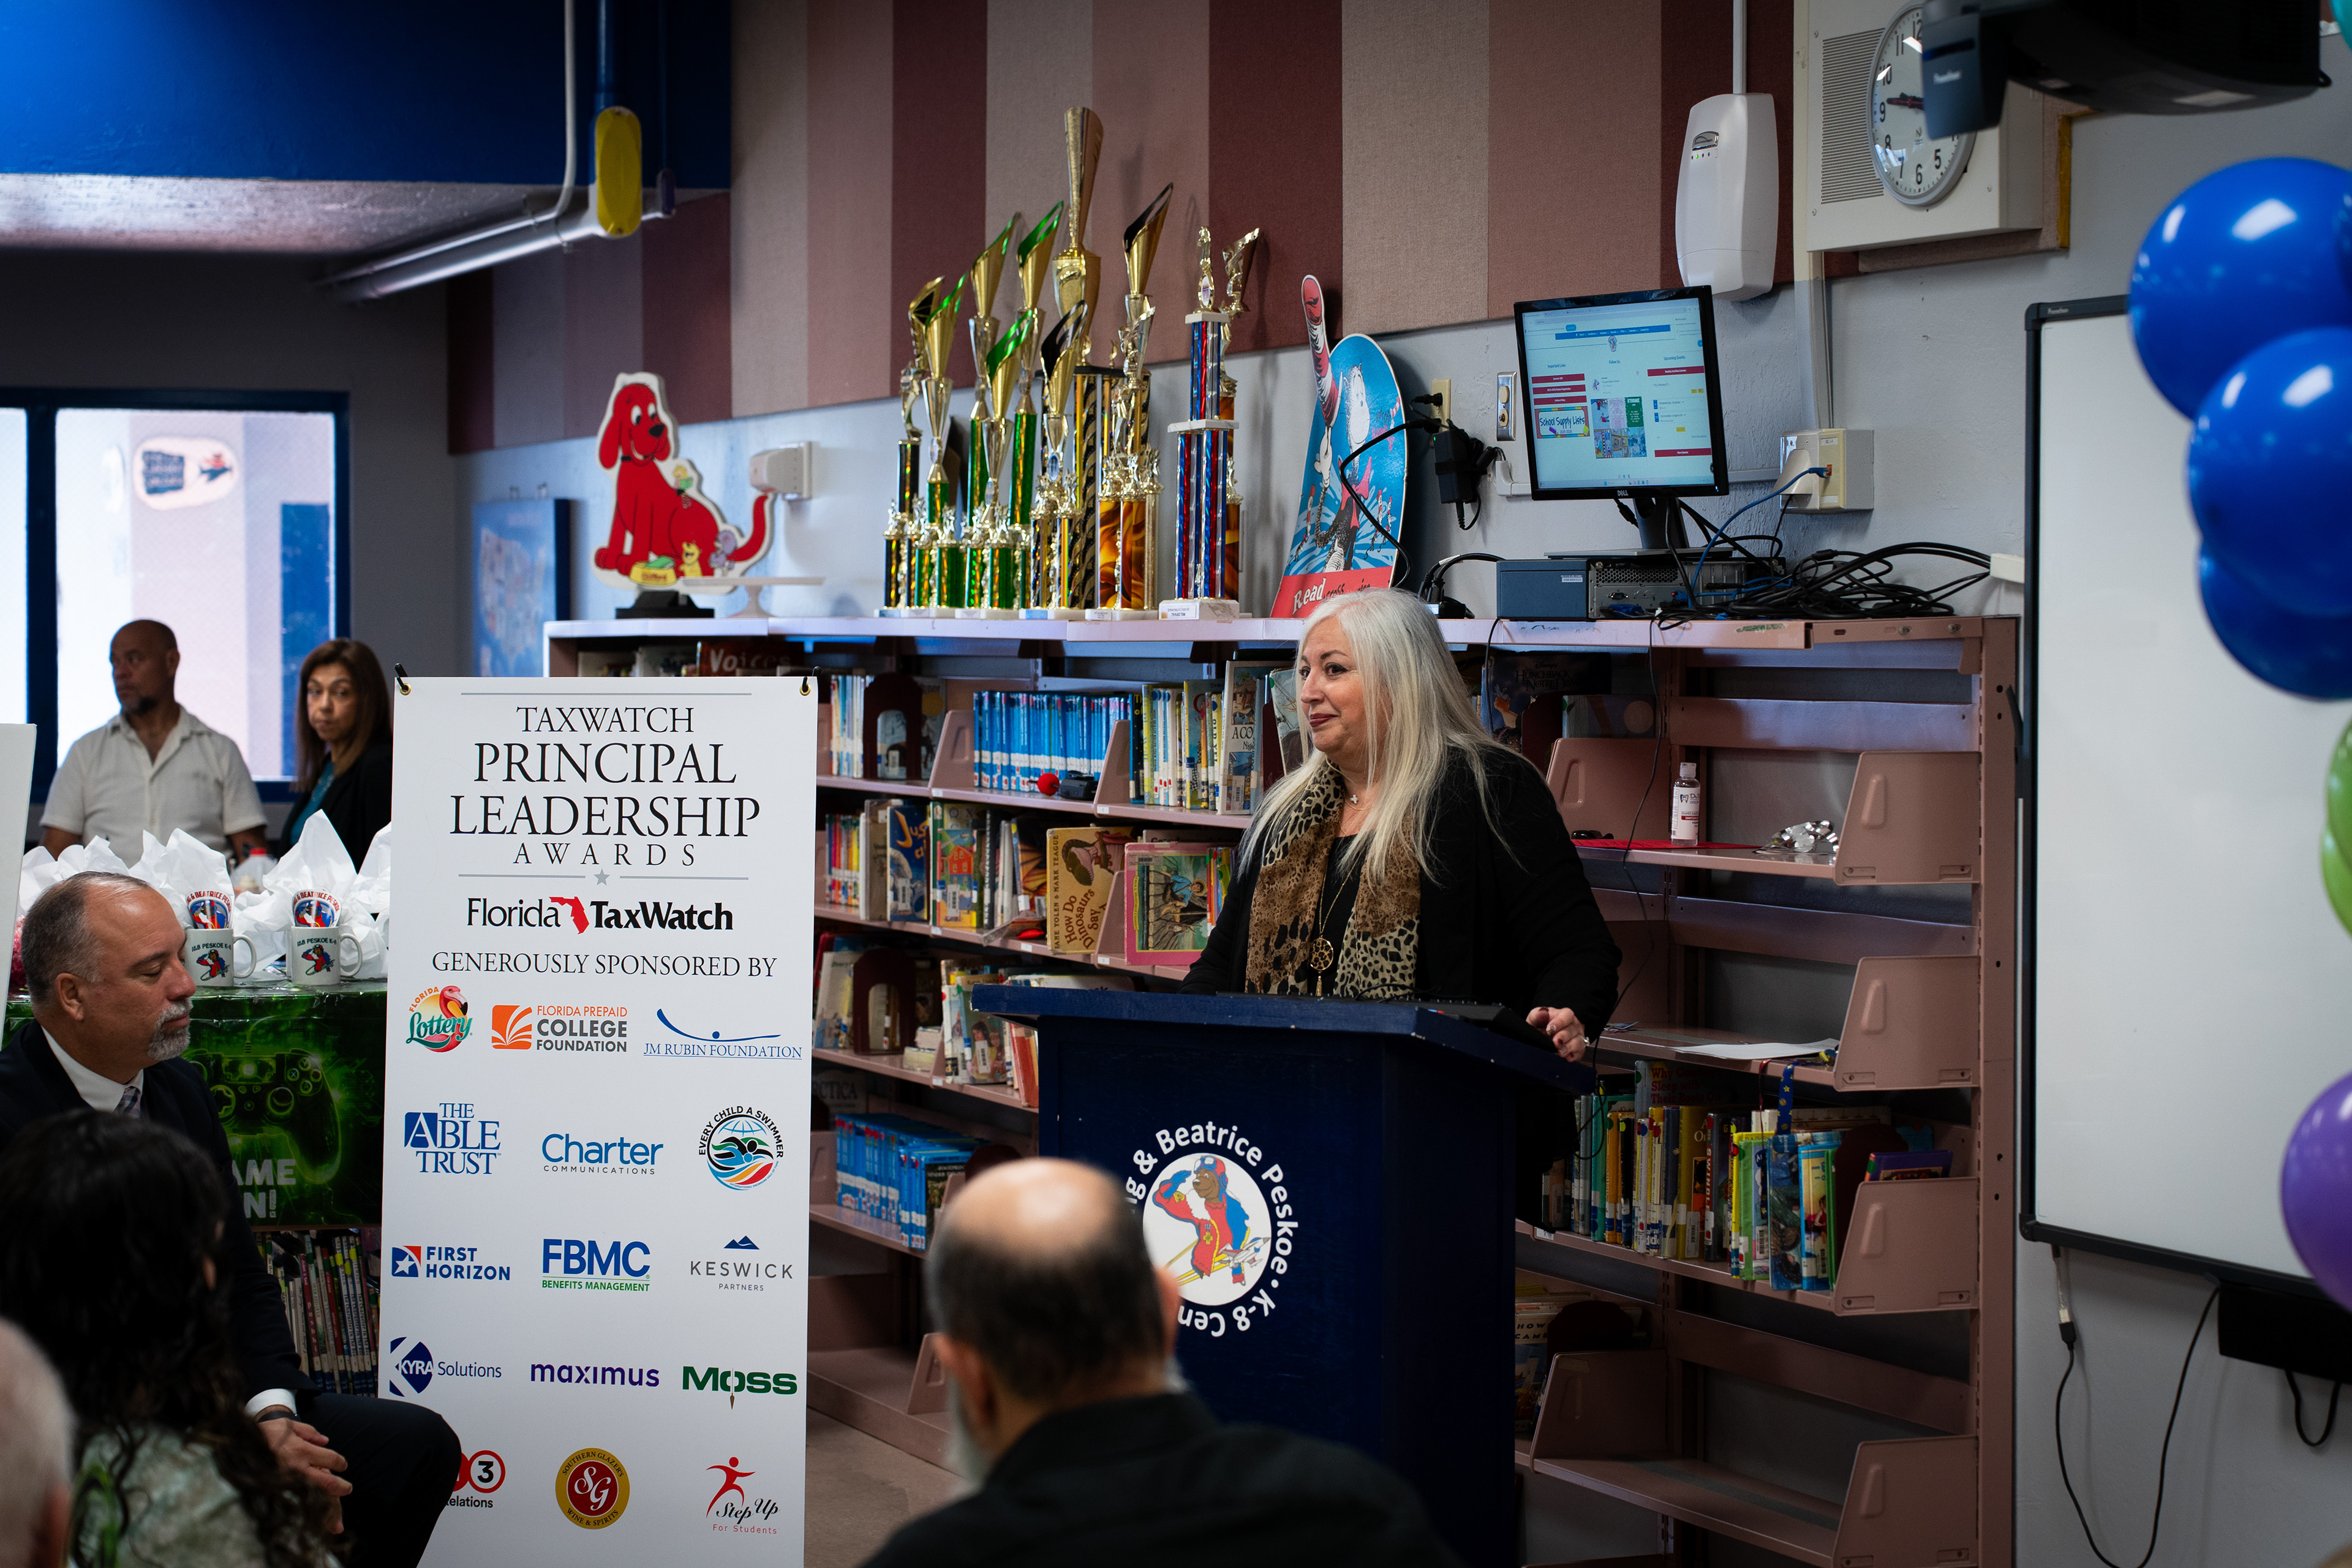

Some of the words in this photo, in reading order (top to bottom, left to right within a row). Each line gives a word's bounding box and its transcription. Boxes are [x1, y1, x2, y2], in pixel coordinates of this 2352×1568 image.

[1879, 102, 1887, 123] 9
[1934, 149, 1942, 170] 5
[1915, 164, 1923, 185] 6
[1539, 417, 1556, 426] School
[1556, 417, 1572, 429] Supply
[1572, 416, 1585, 425] Lists
[1292, 577, 1326, 615] Read
[710, 649, 791, 673] Voices
[1516, 669, 1570, 682] HUNCHBACK
[516, 706, 694, 733] TAXWATCH
[473, 742, 736, 783] PRINCIPAL
[450, 795, 760, 837] LEADERSHIP
[513, 842, 695, 866] AWARDS
[195, 891, 222, 900] BEATRICE
[300, 891, 328, 900] BEATRICE
[1063, 895, 1078, 912] Do
[467, 897, 561, 927] Florida
[590, 900, 734, 931] TaxWatch
[1076, 888, 1095, 950] Dinosaurs
[1087, 909, 1099, 930] Say
[1063, 914, 1078, 945] How
[432, 951, 589, 974] GENEROUSLY
[595, 954, 740, 976] SPONSORED
[748, 957, 777, 977] BY
[409, 986, 439, 1012] FLORIDA
[537, 1005, 581, 1017] FLORIDA
[583, 1006, 627, 1017] PREPAID
[405, 1012, 473, 1049] Lottery
[537, 1019, 627, 1038] COLLEGE
[537, 1039, 627, 1052] FOUNDATION
[643, 1042, 662, 1057] JM
[664, 1042, 707, 1057] RUBIN
[710, 1043, 802, 1058] FOUNDATION
[1651, 1068, 1673, 1080] Why
[1676, 1066, 1721, 1079] Cowboys
[1651, 1080, 1678, 1093] Sleep
[1680, 1080, 1701, 1090] with
[1651, 1093, 1676, 1104] Their
[1679, 1093, 1705, 1102] Boots
[1707, 1091, 1721, 1101] On
[439, 1103, 475, 1118] THE
[404, 1112, 501, 1150] ABLE
[699, 1121, 714, 1155] EVERY
[714, 1106, 744, 1122] CHILD
[755, 1110, 784, 1159] SWIMMER
[542, 1133, 663, 1164] Charter
[1155, 1121, 1264, 1167] Beatrice
[416, 1152, 498, 1174] TRUST
[543, 1165, 655, 1175] COMMUNICATIONS
[1133, 1149, 1158, 1175] &
[1261, 1163, 1299, 1275] Peskoe
[426, 1246, 478, 1262] FIRST
[543, 1238, 650, 1278] FBMC
[426, 1264, 511, 1281] HORIZON
[690, 1261, 793, 1279] KESWICK
[542, 1280, 582, 1290] BENEFITS
[585, 1281, 650, 1292] MANAGEMENT
[1232, 1288, 1276, 1332] K-8
[400, 1360, 434, 1376] KYRA
[437, 1361, 502, 1378] Solutions
[530, 1363, 660, 1387] maximus
[477, 1461, 494, 1483] 3
[562, 1452, 596, 1476] SOUTHERN
[597, 1452, 624, 1477] GLAZER'S
[567, 1507, 584, 1524] WINE
[593, 1510, 619, 1526] SPIRITS
[716, 1502, 753, 1523] Step
[754, 1498, 781, 1520] Up
[733, 1525, 777, 1534] Students
